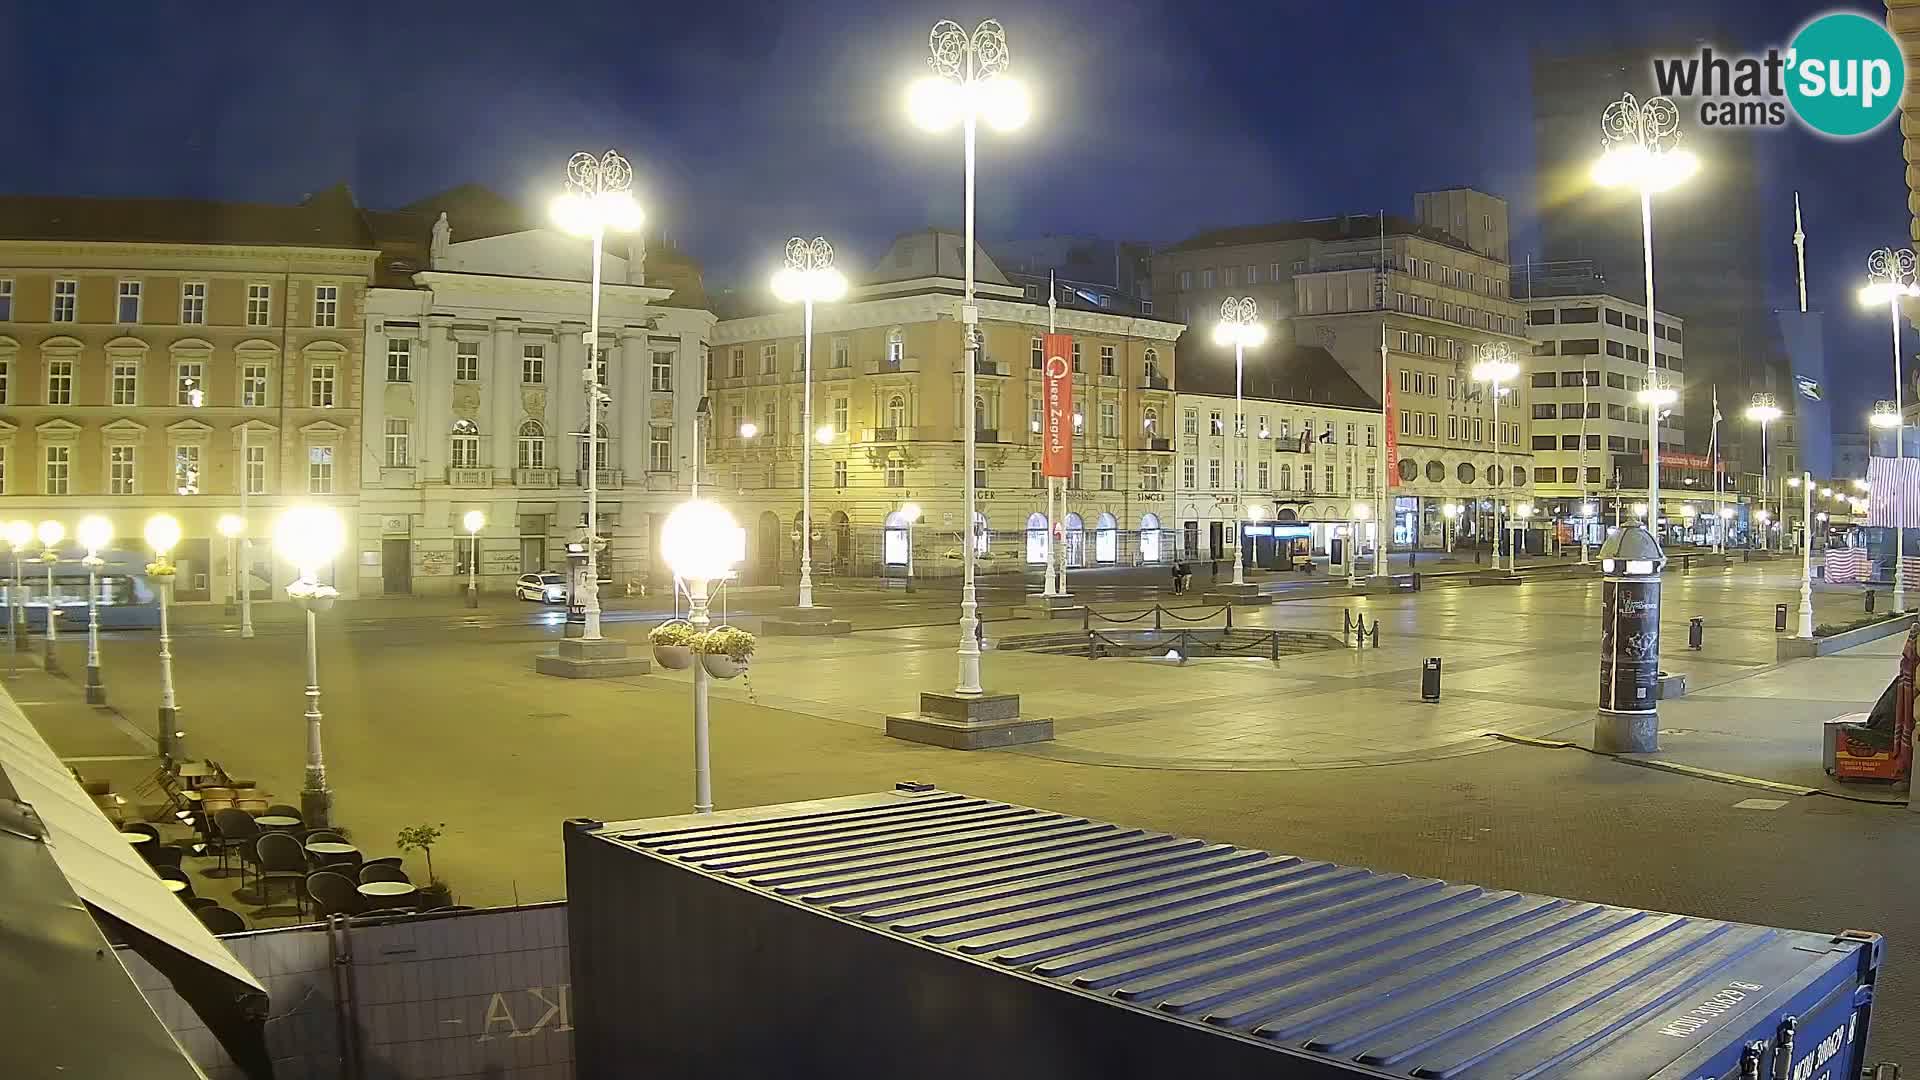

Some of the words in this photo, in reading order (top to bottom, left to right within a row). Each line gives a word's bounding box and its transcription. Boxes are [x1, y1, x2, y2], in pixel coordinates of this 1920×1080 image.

[1050, 408, 1064, 454] Zagreb
[959, 490, 996, 500] SGER
[1136, 492, 1166, 502] SINGER
[1690, 988, 1747, 1018] 300629
